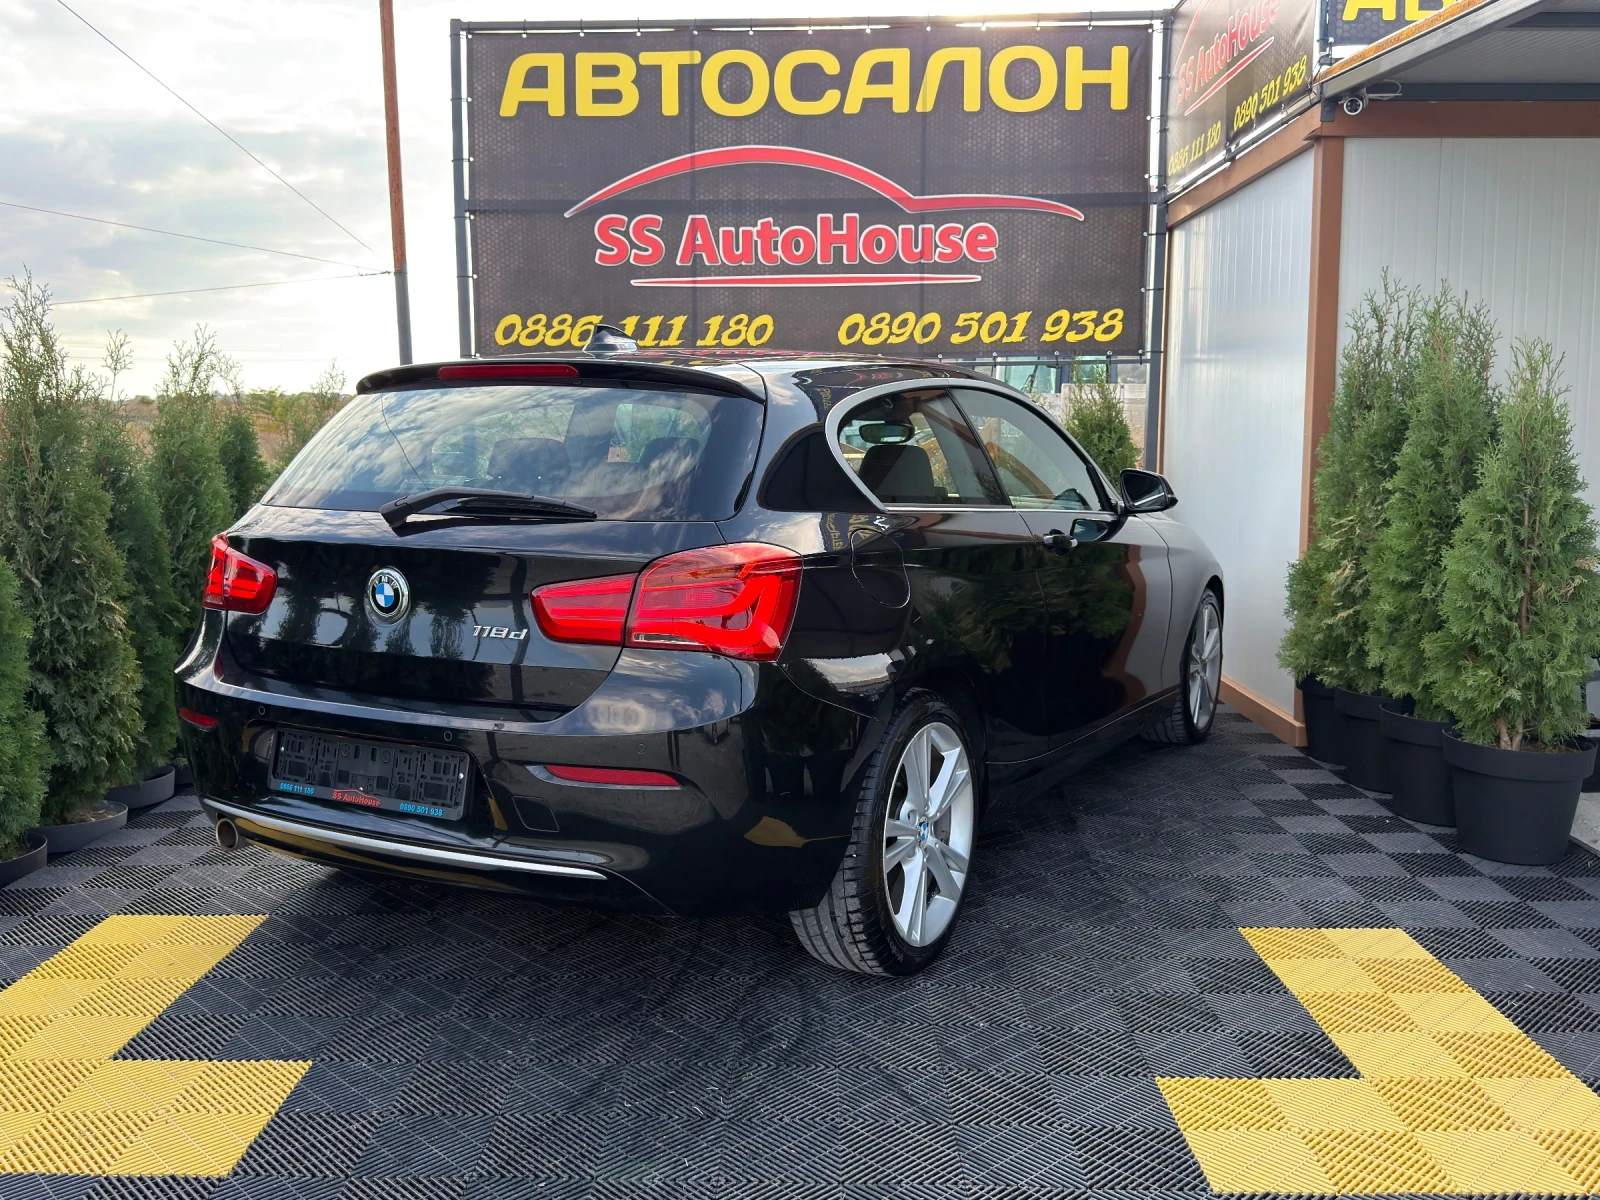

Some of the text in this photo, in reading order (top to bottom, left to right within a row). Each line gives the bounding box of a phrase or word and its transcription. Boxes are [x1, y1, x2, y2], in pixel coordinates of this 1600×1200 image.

[1177, 0, 1281, 105] SS AutoHouse
[499, 45, 1129, 117] АВТОСАЛОН
[1233, 54, 1307, 132] 0890 501 938
[1189, 133, 1205, 163] 111
[1205, 120, 1221, 153] 180
[594, 212, 999, 266] SS AutoHouse
[696, 313, 774, 347] 180
[837, 308, 1124, 345] 0890 501 938
[472, 625, 528, 640] 118d
[332, 791, 381, 808] SS AutoHouse
[416, 805, 429, 814] 501
[430, 807, 443, 817] 938
